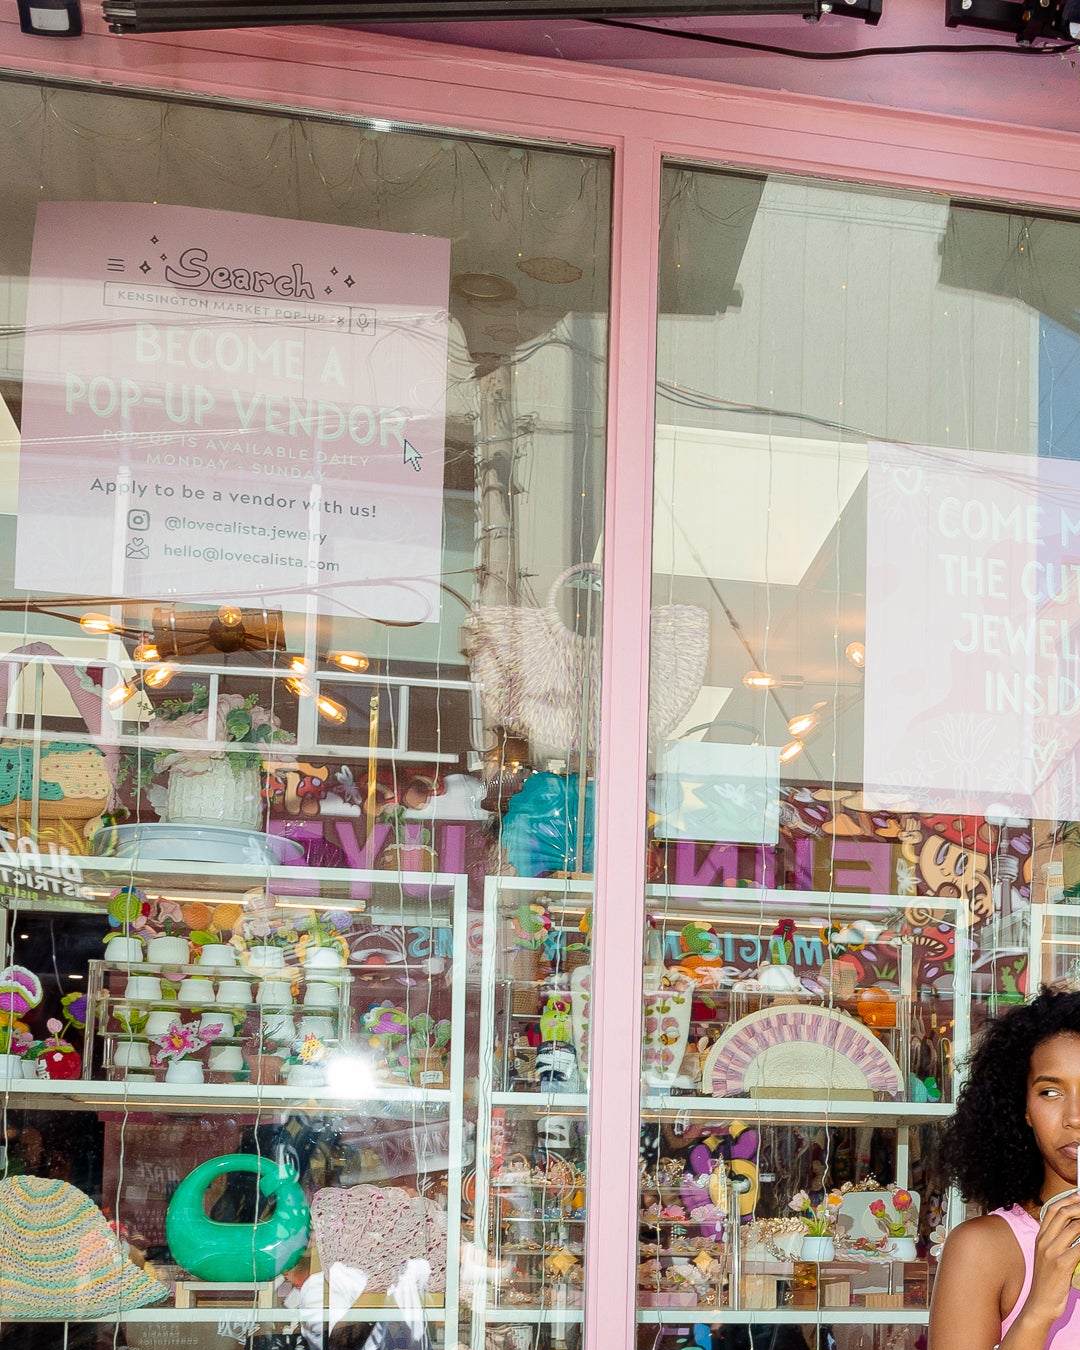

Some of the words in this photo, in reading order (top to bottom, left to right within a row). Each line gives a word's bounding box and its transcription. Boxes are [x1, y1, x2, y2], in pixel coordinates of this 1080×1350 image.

[164, 247, 315, 300] Search
[117, 290, 209, 309] KENSINGTON
[213, 300, 270, 316] MARKET
[275, 308, 325, 323] POP-UP
[135, 321, 304, 382] BECOME
[320, 344, 345, 387] A
[64, 371, 216, 426] POP-UP
[232, 388, 410, 450] VENDOR
[145, 452, 229, 471] MONDAY
[252, 461, 327, 481] SUNDAY
[181, 435, 198, 448] IS
[206, 438, 309, 462] AVAILABLE
[316, 451, 370, 467] DAILY
[90, 478, 148, 498] Apply
[155, 483, 174, 498] to
[182, 484, 206, 501] be
[212, 489, 223, 502] a
[229, 490, 296, 511] vendor
[302, 497, 343, 515] with
[350, 504, 377, 518] us!
[164, 515, 327, 545] @lovecalista.jewelry
[937, 496, 1045, 547] COME
[163, 543, 340, 572] hello@lovecalista.com
[938, 553, 1006, 600] THE
